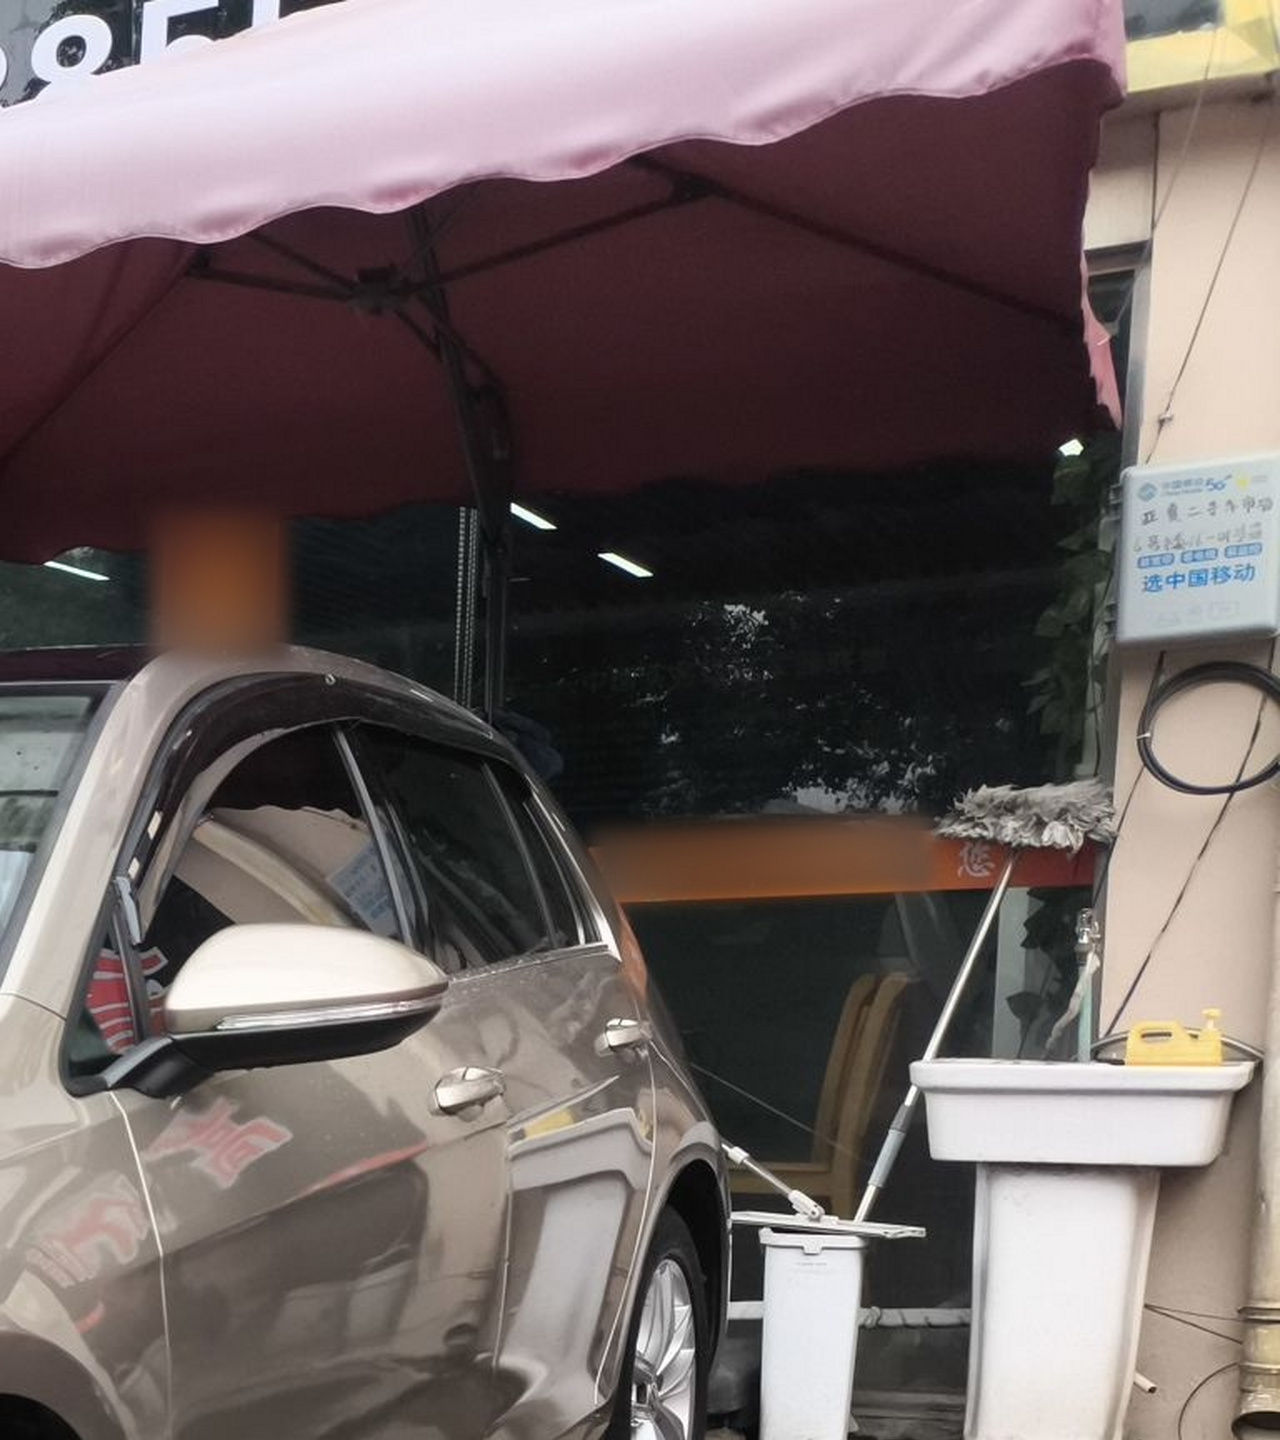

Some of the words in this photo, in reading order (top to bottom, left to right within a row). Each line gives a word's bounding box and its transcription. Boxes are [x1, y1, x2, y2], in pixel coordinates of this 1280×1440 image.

[1142, 563, 1255, 593] 选中国移动
